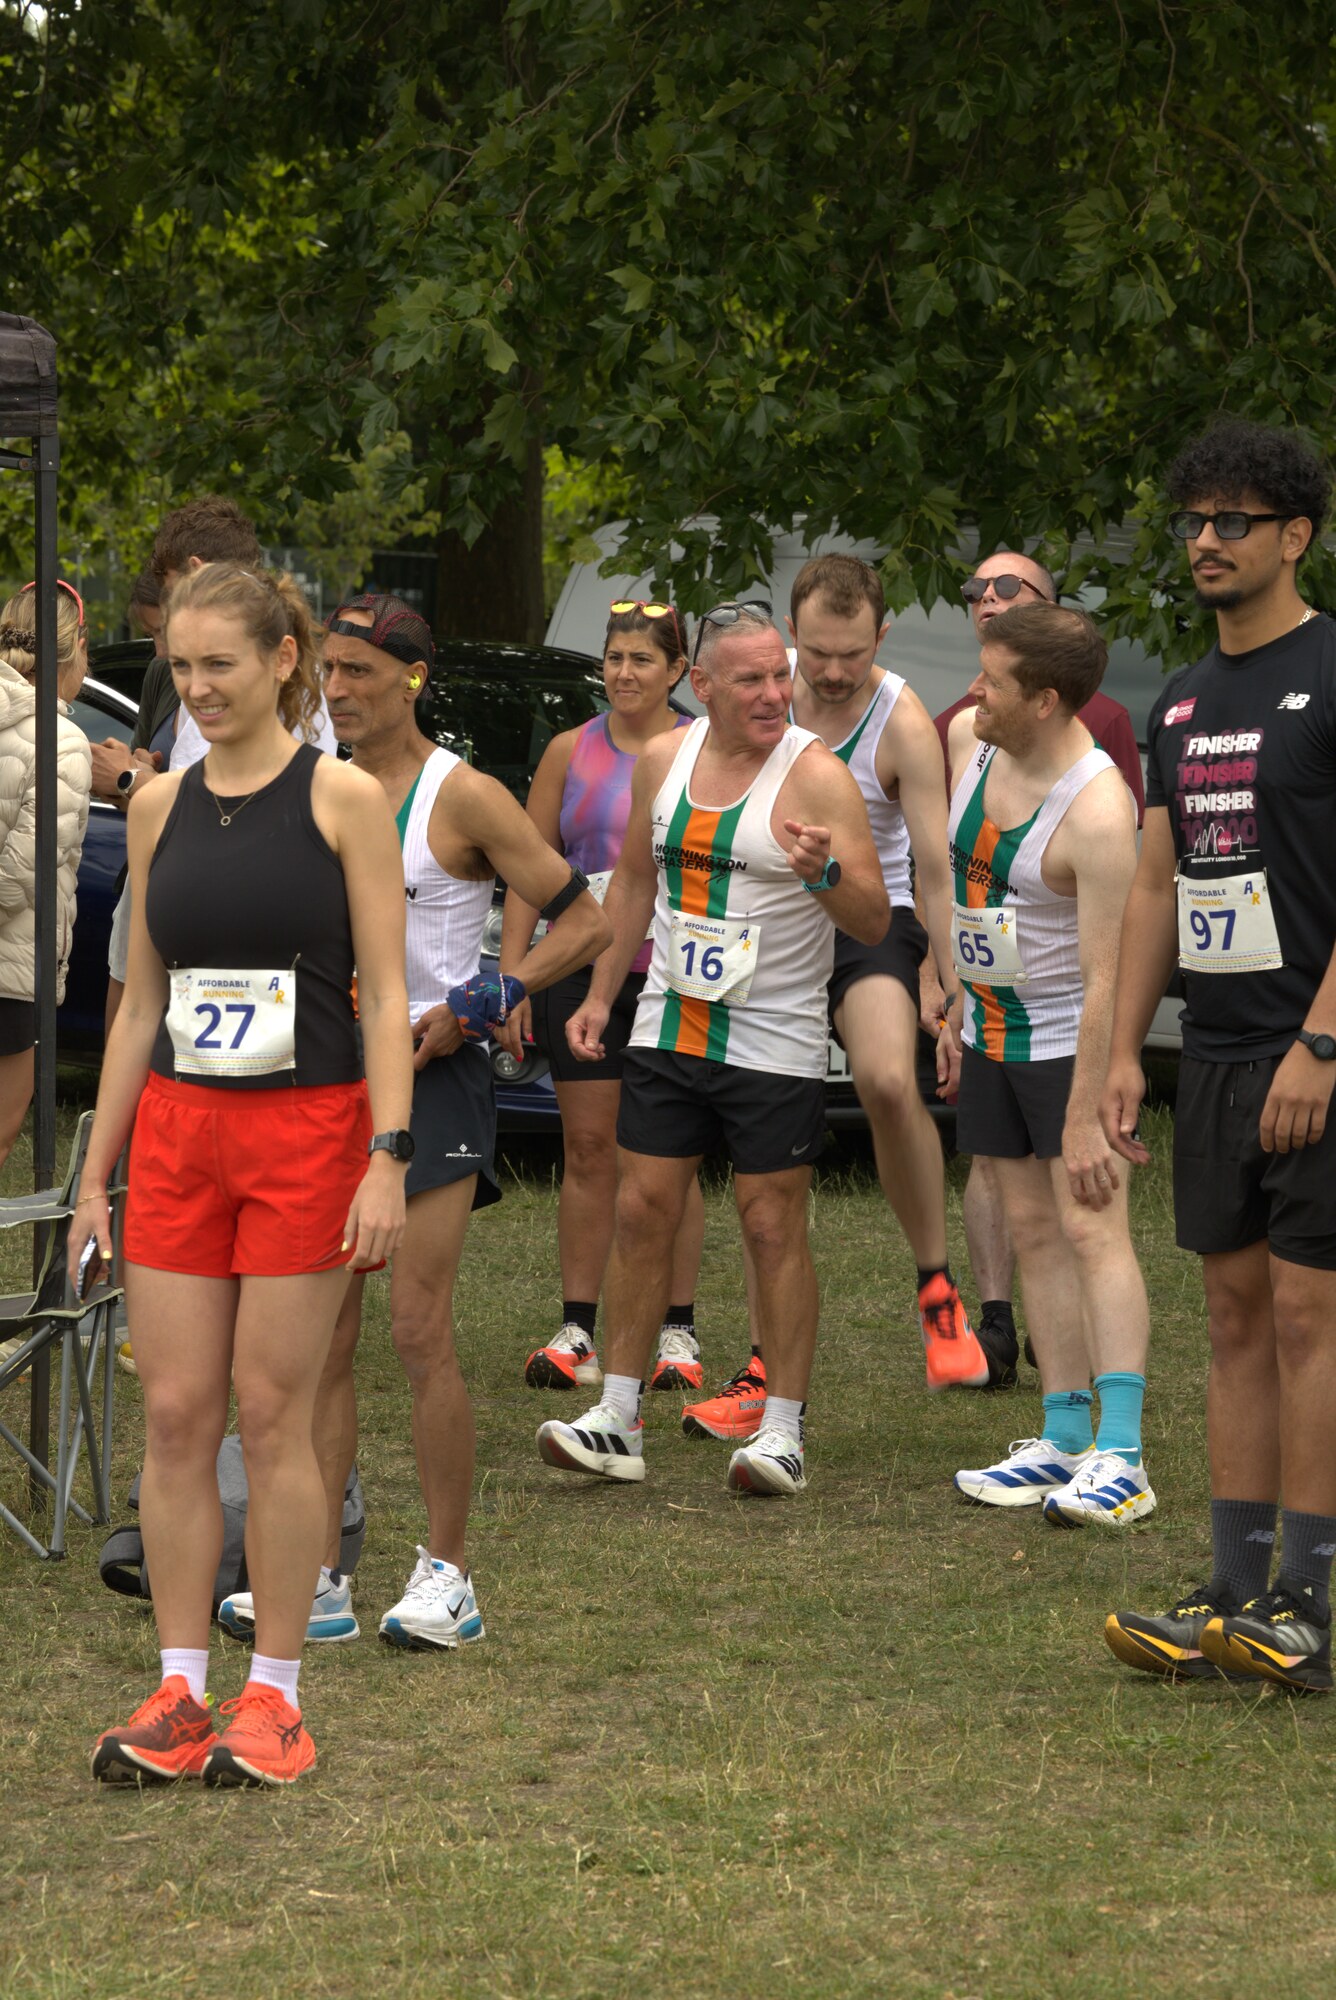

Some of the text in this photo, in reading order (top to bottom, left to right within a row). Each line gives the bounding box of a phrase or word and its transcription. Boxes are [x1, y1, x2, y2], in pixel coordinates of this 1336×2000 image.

[1187, 733, 1261, 756] FINISHER
[977, 743, 991, 772] oar
[1183, 761, 1255, 784] FINISHER
[1184, 791, 1255, 813] FINISHER
[655, 844, 747, 871] MORNINGTON
[655, 855, 715, 872] CHASERS
[1187, 889, 1227, 897] AFFORDABLE
[684, 921, 726, 935] AFFORDABLE
[1190, 909, 1236, 951] 97
[959, 931, 994, 967] 65
[680, 941, 724, 981] 16
[198, 979, 250, 988] AFFORDABLE
[203, 990, 244, 998] RUNNING
[194, 1003, 256, 1049] 27
[739, 1401, 767, 1411] BROO
